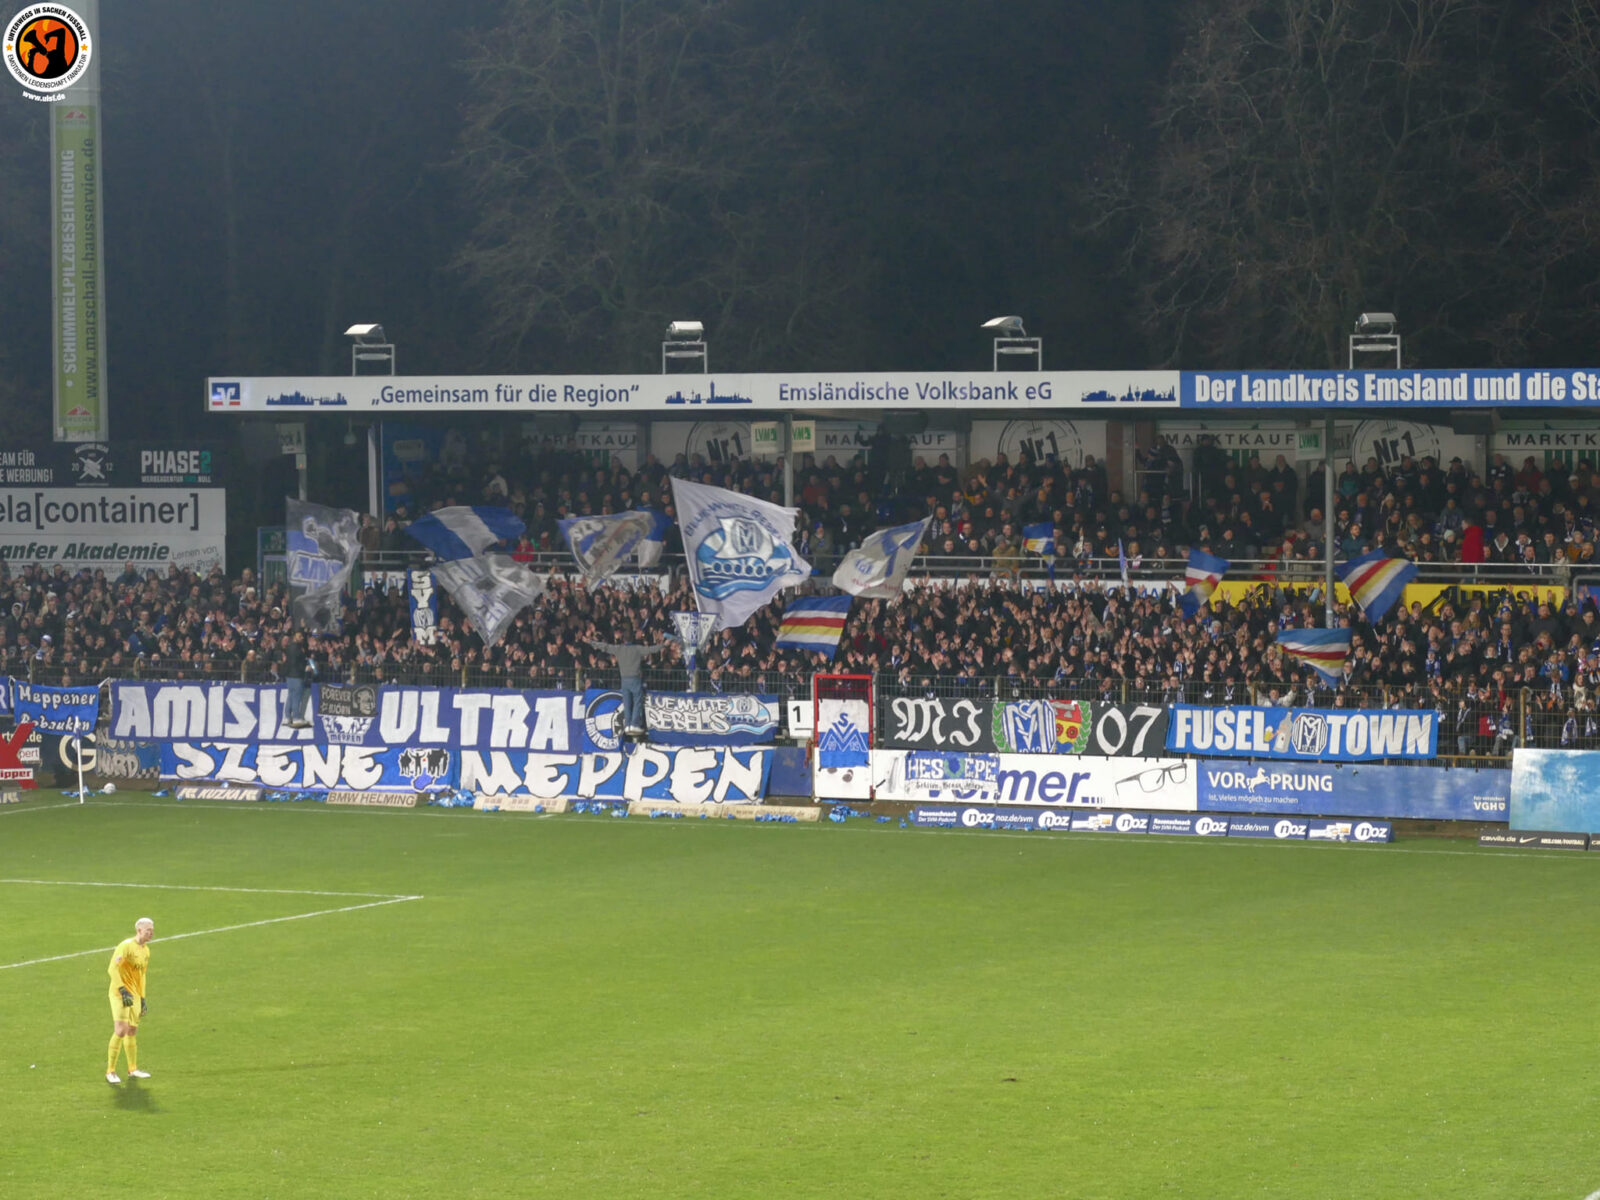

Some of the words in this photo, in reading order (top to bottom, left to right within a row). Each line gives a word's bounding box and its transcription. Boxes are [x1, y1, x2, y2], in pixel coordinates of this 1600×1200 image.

[61, 150, 77, 374] SCHIMMELPILZBESEITIGUNG
[81, 137, 97, 399] www.marschall-hausservice.de
[495, 385, 522, 403] für
[528, 385, 558, 402] die
[779, 381, 910, 401] Emsländische
[916, 381, 1018, 401] Volksbank
[1025, 381, 1052, 400] eG
[1195, 374, 1236, 402] Der
[1241, 373, 1358, 402] Landkreis
[1364, 372, 1468, 401] Emsland
[1474, 372, 1520, 400] und
[1526, 372, 1566, 400] die
[1571, 371, 1600, 400] St
[17, 449, 36, 466] FÜR
[141, 450, 212, 474] PHASE2
[6, 468, 54, 483] WERBUNG!
[62, 542, 170, 561] Akademie
[19, 684, 97, 710] Meppener
[1096, 705, 1163, 756] 07
[1176, 709, 1270, 752] FUSEL
[1326, 713, 1432, 756] TOWN
[459, 745, 764, 803] MEPPEN
[328, 792, 360, 803] BMW
[361, 793, 416, 806] HELMING
[1474, 801, 1499, 811] VGH
